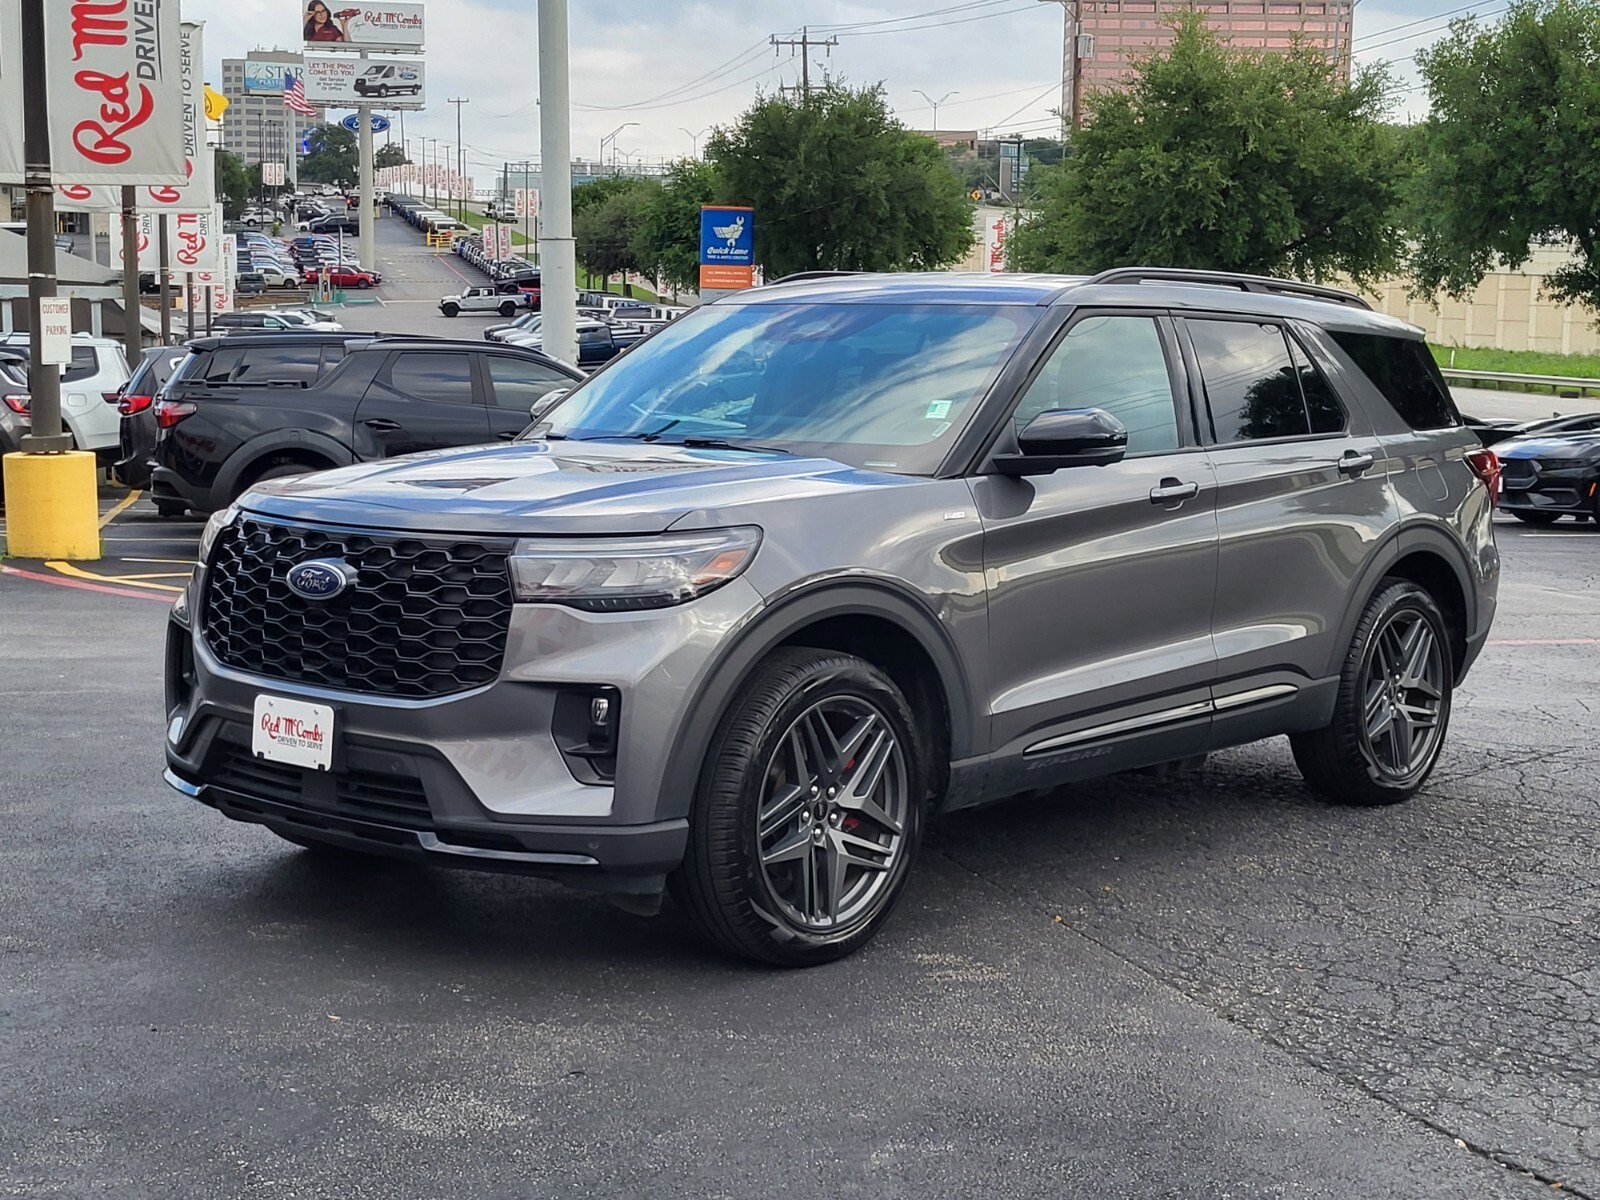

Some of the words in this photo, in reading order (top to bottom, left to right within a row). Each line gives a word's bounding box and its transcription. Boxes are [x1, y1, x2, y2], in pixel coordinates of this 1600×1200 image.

[364, 10, 381, 27] Red
[133, 0, 157, 81] DRIVE
[180, 32, 191, 75] SERVE
[265, 65, 303, 80] STAR
[182, 80, 192, 98] TO
[73, 70, 154, 165] Red
[183, 103, 195, 157] DRIVEN
[176, 231, 206, 265] Red
[707, 246, 729, 254] Quick
[730, 247, 749, 255] Lane
[42, 303, 69, 314] CUSTOMER
[46, 325, 67, 335] PARKING
[297, 568, 331, 591] Ford
[261, 712, 280, 740] Red
[282, 716, 323, 743] McCombs
[277, 735, 297, 747] DRIVEN
[298, 739, 306, 748] TO
[306, 740, 323, 751] SERVE
